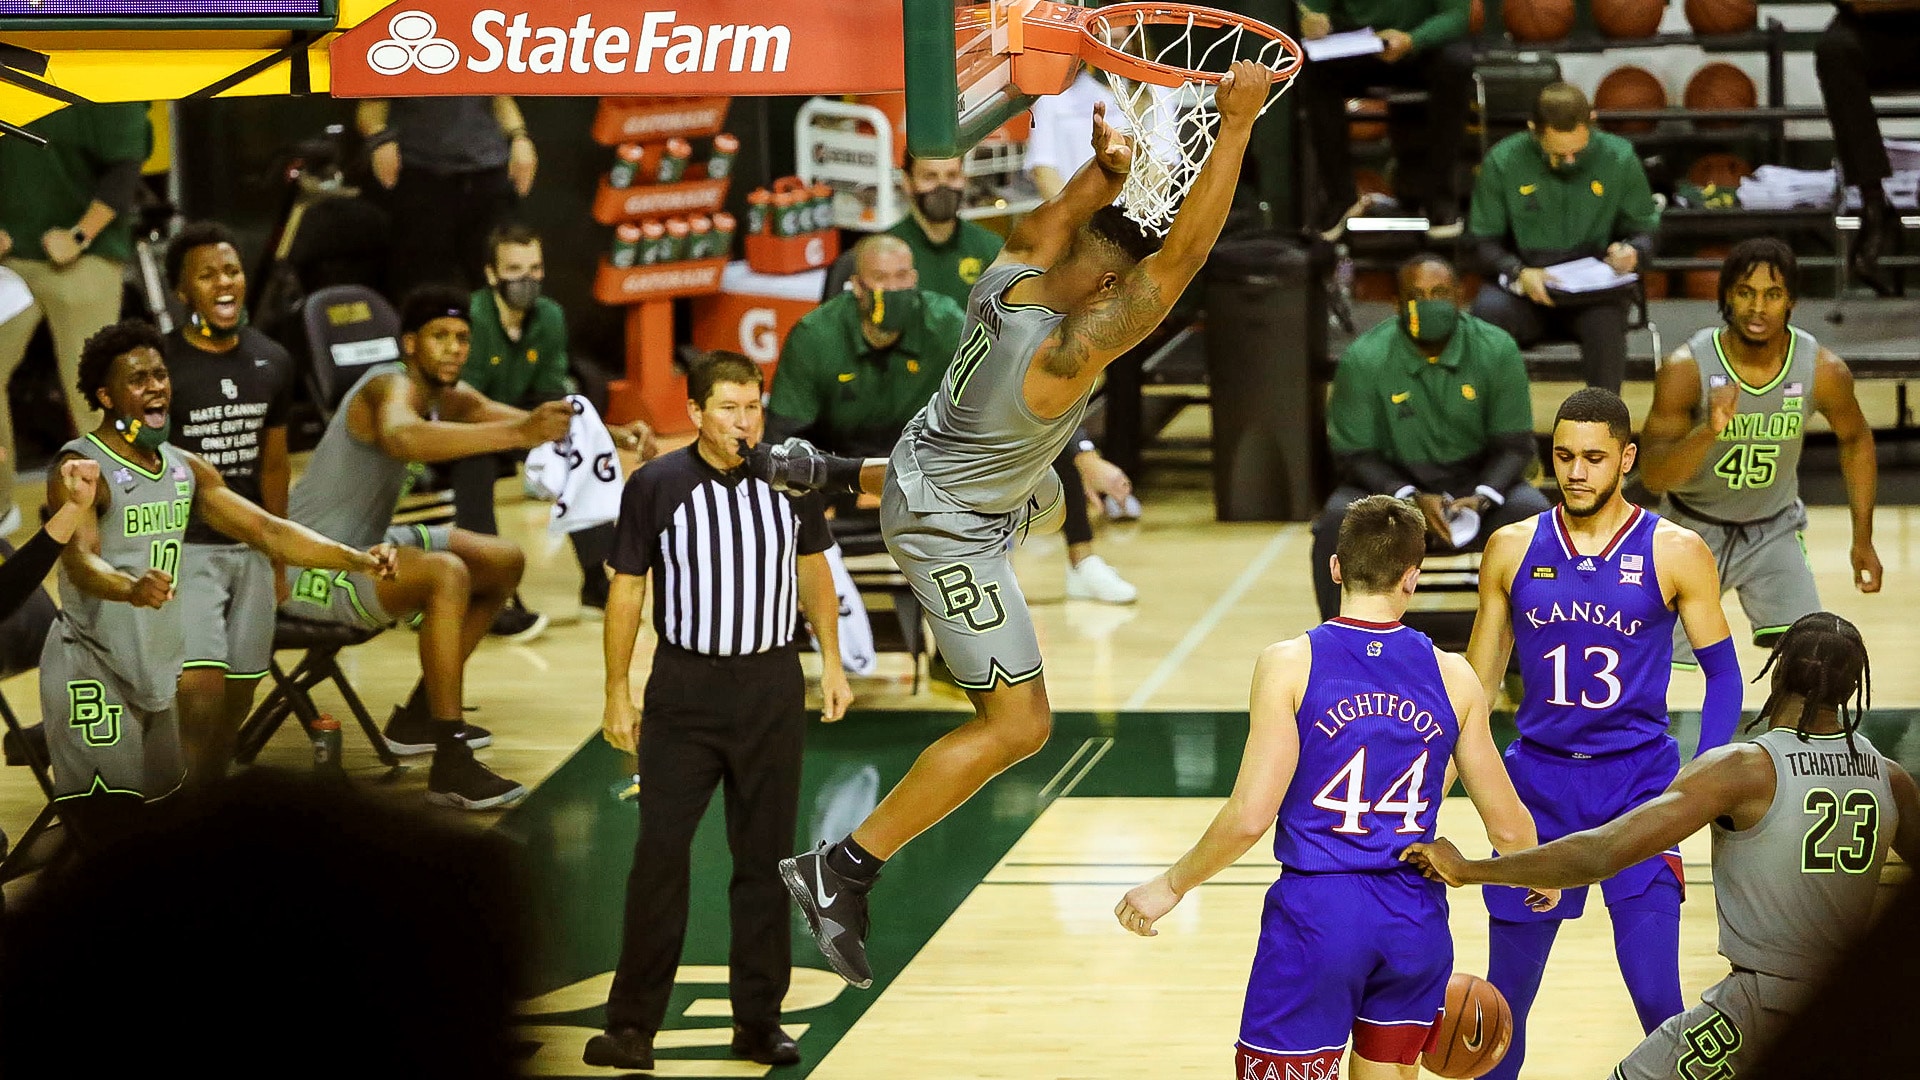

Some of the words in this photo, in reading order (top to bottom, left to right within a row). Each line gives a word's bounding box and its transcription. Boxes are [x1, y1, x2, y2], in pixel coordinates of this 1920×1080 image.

[467, 9, 631, 74] State
[634, 10, 791, 73] Farm
[738, 308, 779, 364] G
[1716, 412, 1803, 441] AYLOR
[593, 452, 617, 483] G
[1713, 444, 1780, 490] 45
[150, 538, 181, 590] 10
[928, 561, 1008, 634] BU
[1525, 600, 1642, 636] KANSAS
[1543, 643, 1622, 710] 13
[67, 680, 122, 747] BU
[1314, 692, 1444, 744] LIGHTFOOT
[1311, 745, 1431, 835] 44
[1785, 752, 1880, 781] TCHATCHOUA
[1801, 787, 1880, 874] 23
